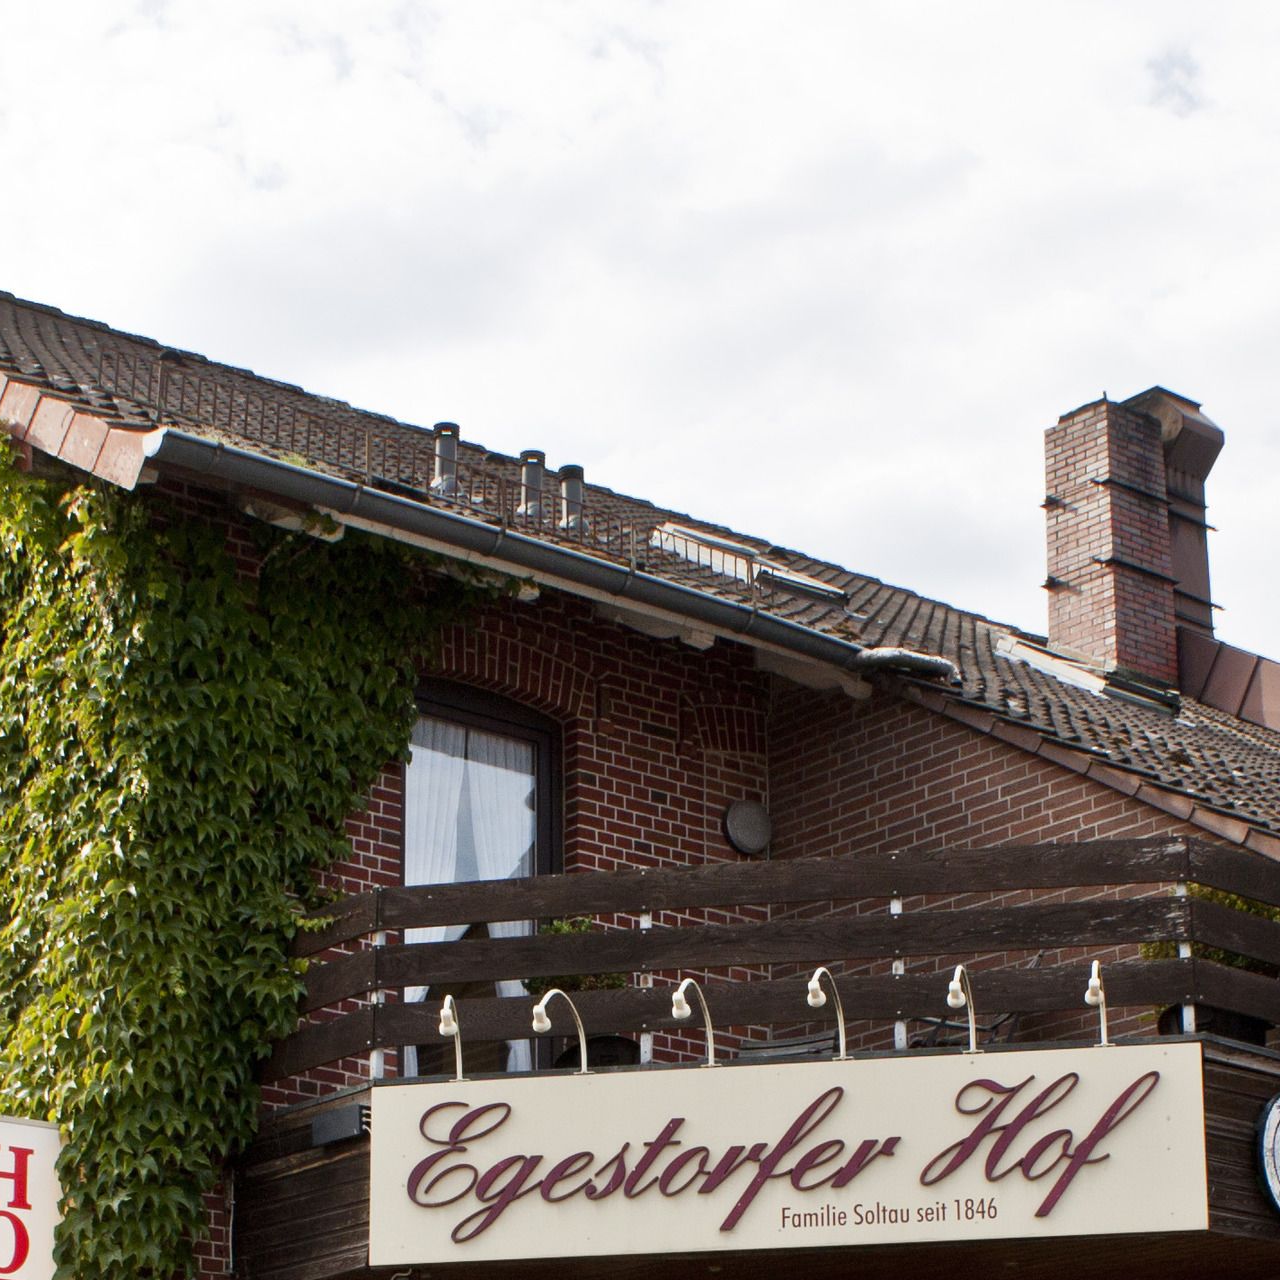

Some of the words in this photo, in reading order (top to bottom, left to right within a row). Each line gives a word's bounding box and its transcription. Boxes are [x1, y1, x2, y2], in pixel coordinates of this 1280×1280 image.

[407, 1087, 901, 1244] Egestorfer
[920, 1071, 1160, 1219] Hof
[782, 1204, 847, 1228] Familie
[853, 1202, 910, 1225] Soltau
[917, 1201, 947, 1222] seit
[954, 1198, 998, 1220] 1846
